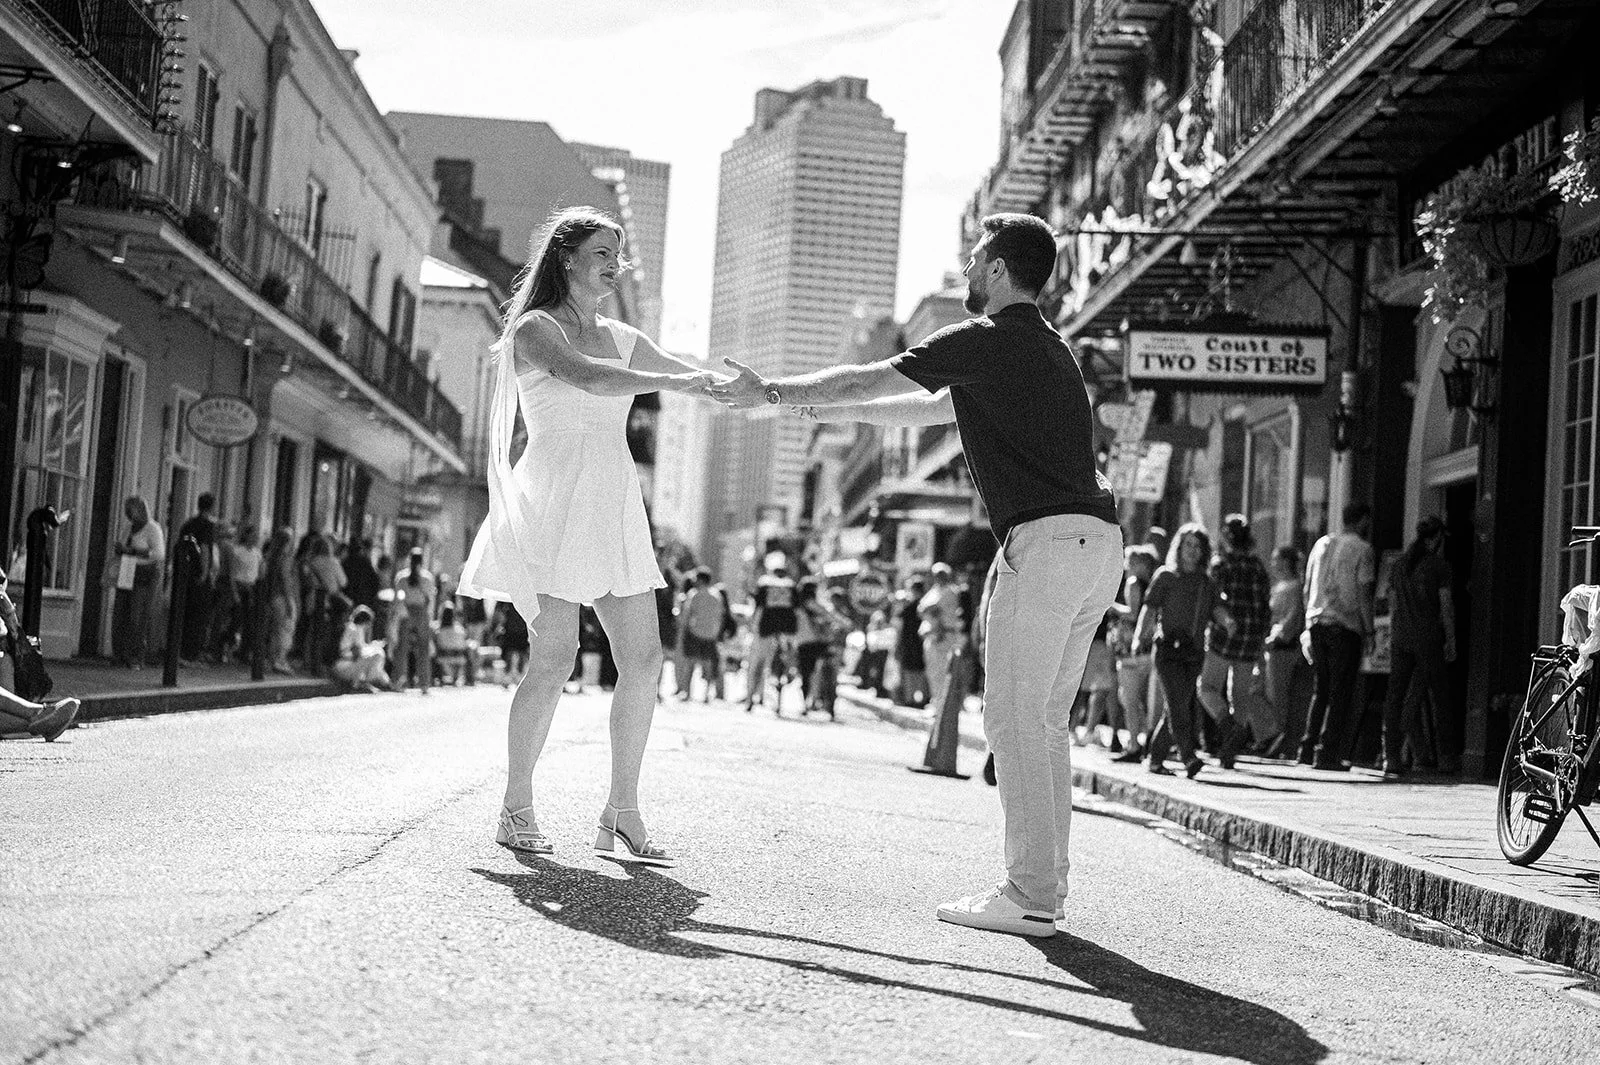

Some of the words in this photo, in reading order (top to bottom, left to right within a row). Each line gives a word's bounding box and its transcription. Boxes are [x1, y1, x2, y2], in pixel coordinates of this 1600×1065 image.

[1514, 115, 1556, 175] THE
[1206, 336, 1269, 352] Court
[1280, 339, 1304, 357] of
[1138, 352, 1196, 371] TWO
[1206, 354, 1317, 375] SISTERS
